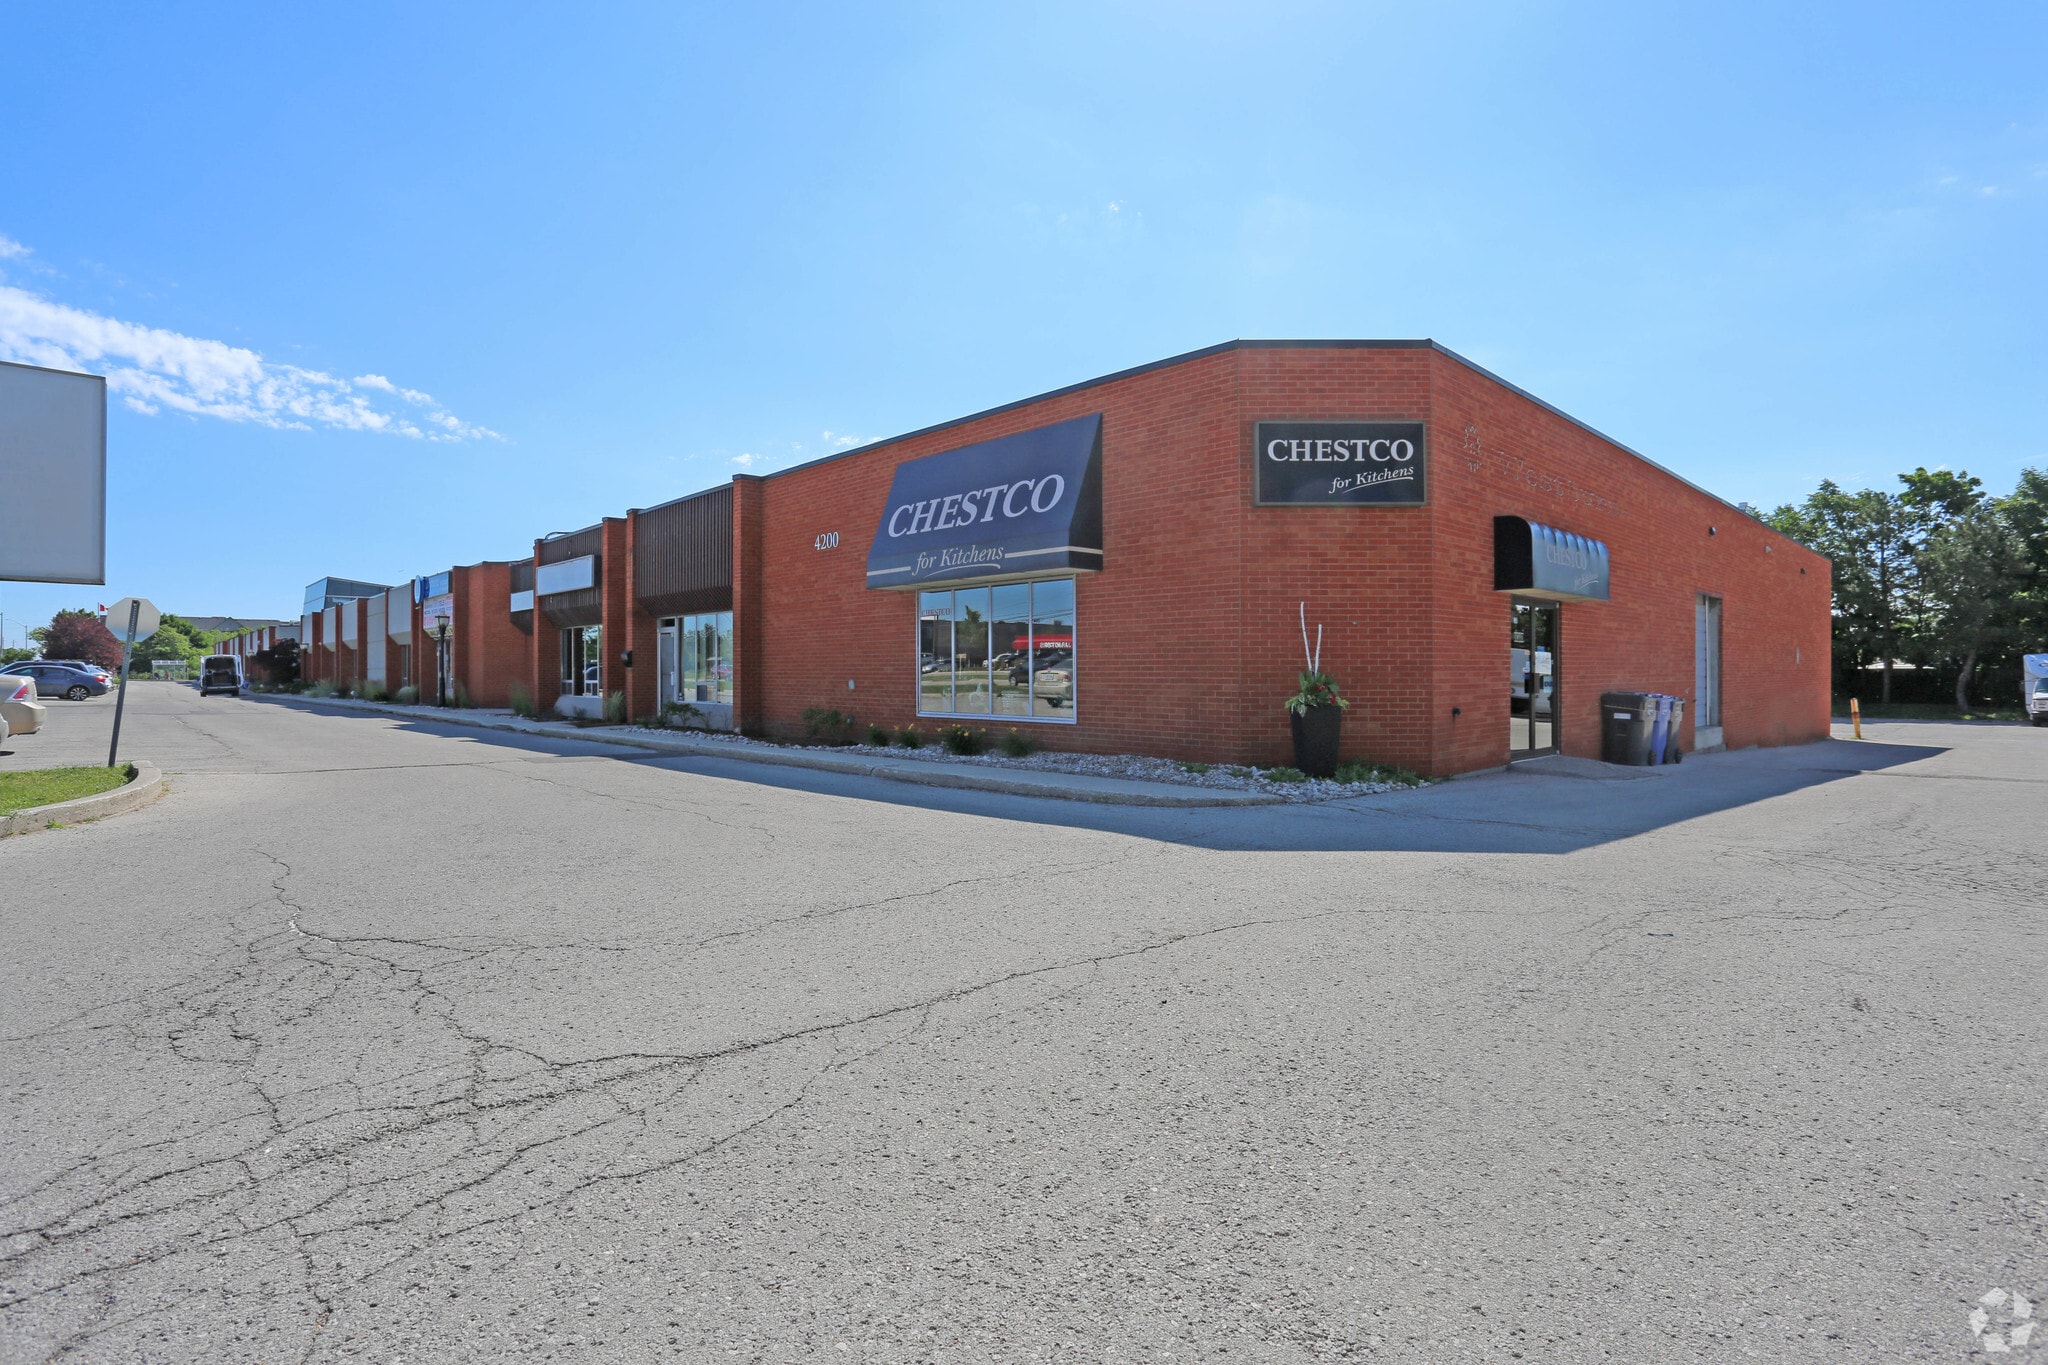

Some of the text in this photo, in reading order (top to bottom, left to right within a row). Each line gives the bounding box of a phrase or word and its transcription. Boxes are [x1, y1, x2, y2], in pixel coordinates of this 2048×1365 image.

[1267, 439, 1414, 462] CHESTCO
[1328, 466, 1414, 494] for Kitchens
[888, 474, 1065, 538] CHESTCO
[814, 531, 839, 551] 4200
[911, 544, 1004, 576] for Kitchens
[1546, 544, 1587, 570] CHESTCO
